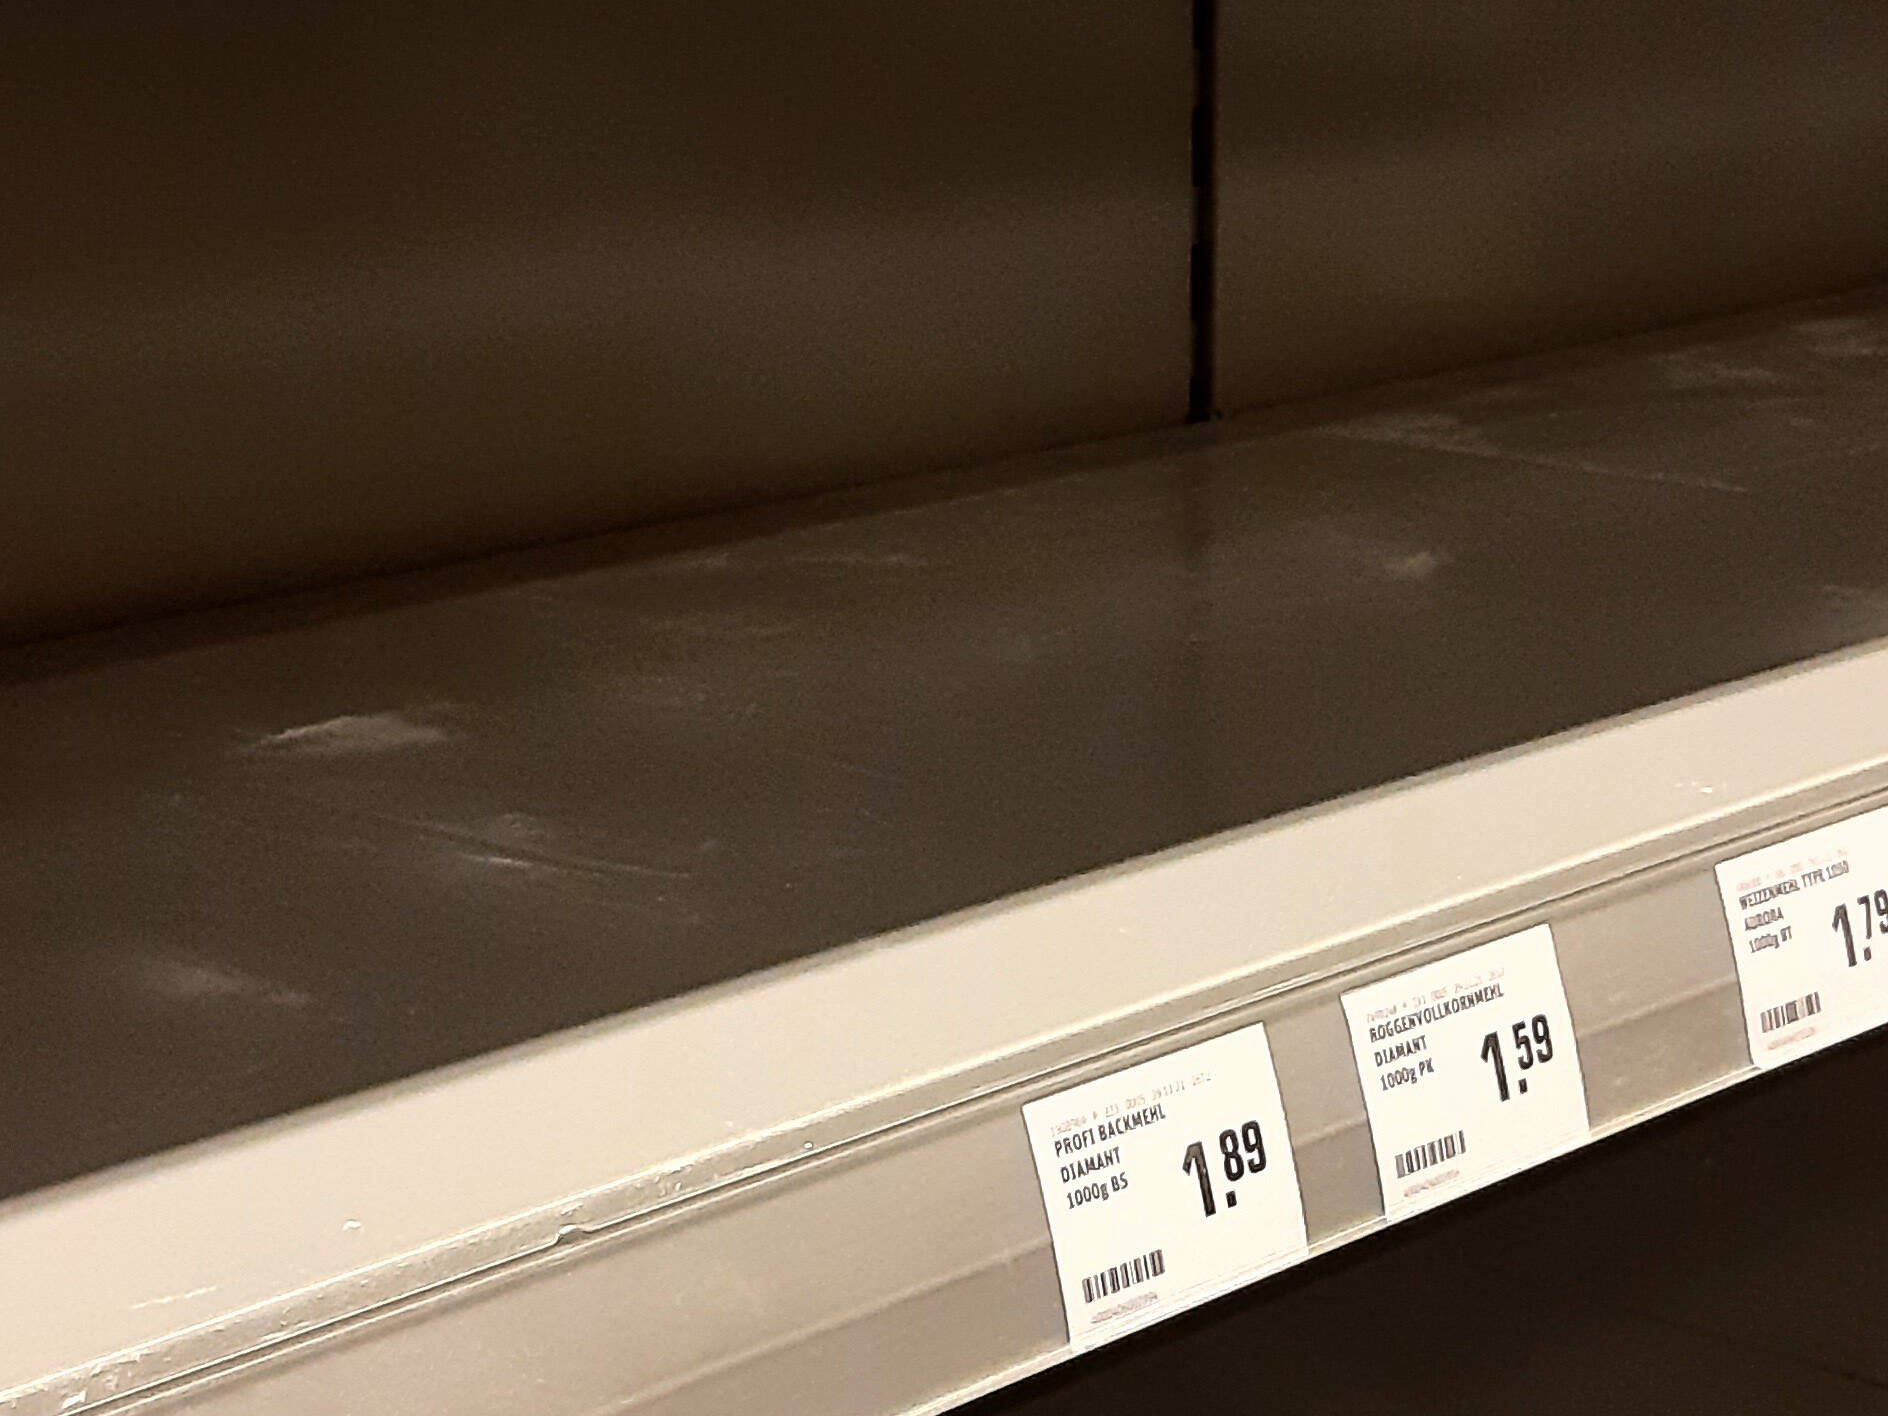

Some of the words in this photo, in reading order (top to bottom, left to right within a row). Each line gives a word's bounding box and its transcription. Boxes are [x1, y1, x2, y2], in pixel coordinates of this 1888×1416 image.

[1369, 983, 1504, 1043] ROGGENVOLLKORNMEHL
[1374, 1035, 1427, 1067] DIAMANT
[1480, 1014, 1553, 1102] 1.59
[1380, 1067, 1417, 1091] 1000g
[1419, 1058, 1434, 1078] PK
[1054, 1129, 1096, 1158] PROFI
[1098, 1102, 1166, 1143] BACKMEHL
[1060, 1147, 1121, 1184] DIAMANT
[1182, 1120, 1266, 1217] 1.89
[1066, 1182, 1109, 1210] 1000g
